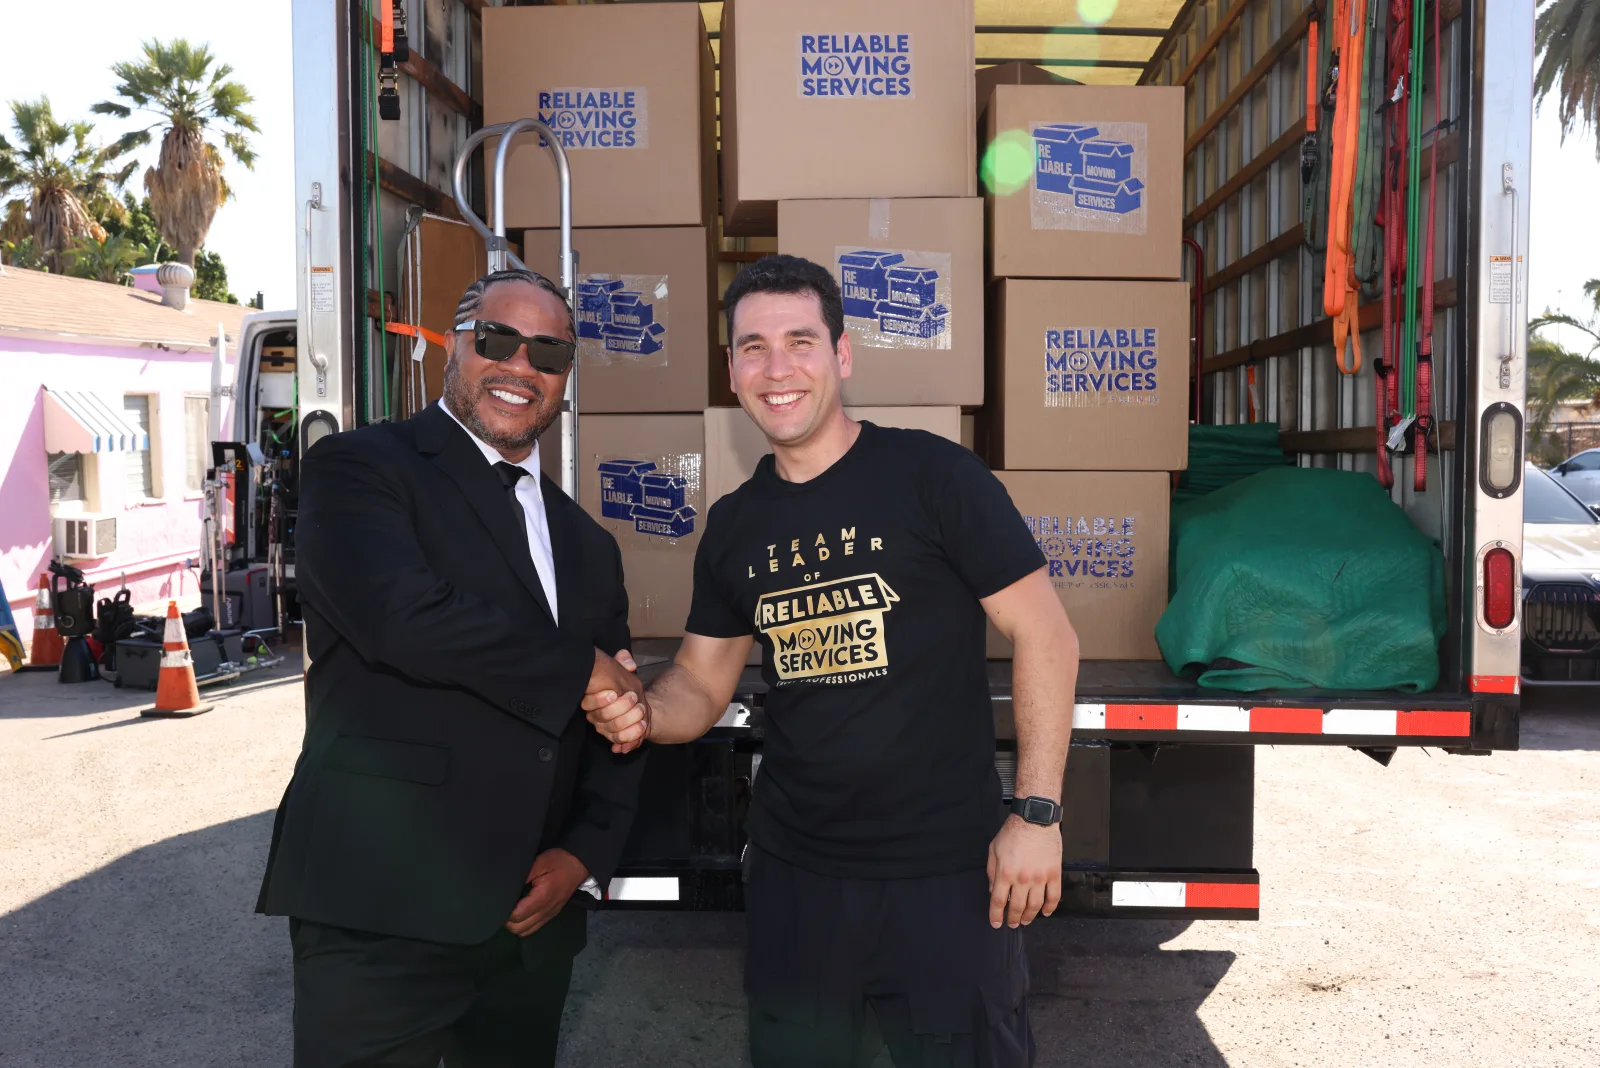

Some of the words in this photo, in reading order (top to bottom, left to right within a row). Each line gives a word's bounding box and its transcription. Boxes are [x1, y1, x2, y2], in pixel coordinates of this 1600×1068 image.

[801, 34, 910, 54] RELIABLE
[801, 55, 911, 76] MOVING
[802, 77, 911, 97] SERVICES
[538, 91, 636, 109] RELIABLE
[538, 110, 637, 129] MOVING
[538, 130, 637, 148] RVICES
[1037, 143, 1051, 159] RE
[1038, 159, 1072, 177] LIABLE
[1086, 165, 1115, 180] MOVING
[1078, 194, 1115, 210] SERVICES
[843, 269, 857, 285] RE
[844, 284, 877, 302] LIABLE
[891, 289, 920, 305] MOVING
[577, 297, 583, 309] E
[577, 310, 602, 325] IABLE
[614, 313, 640, 325] MOVING
[882, 318, 920, 334] SERVICES
[608, 338, 640, 351] SERVICES
[1046, 328, 1157, 349] RELIABLE
[1046, 349, 1158, 372] MOVING
[1046, 372, 1157, 393] SERVICES
[602, 476, 614, 490] RE
[603, 490, 633, 506] LIABLE
[645, 495, 671, 508] MOVING
[638, 520, 671, 535] SERVICES
[1023, 515, 1136, 536] RELIABLE
[766, 526, 857, 558] TEAM
[748, 537, 884, 579] LEADER
[803, 571, 821, 582] OF
[1048, 559, 1135, 578] RVICES
[761, 584, 879, 625] RELIABLE
[776, 619, 878, 653] MOVING
[779, 642, 879, 674] SERVICES
